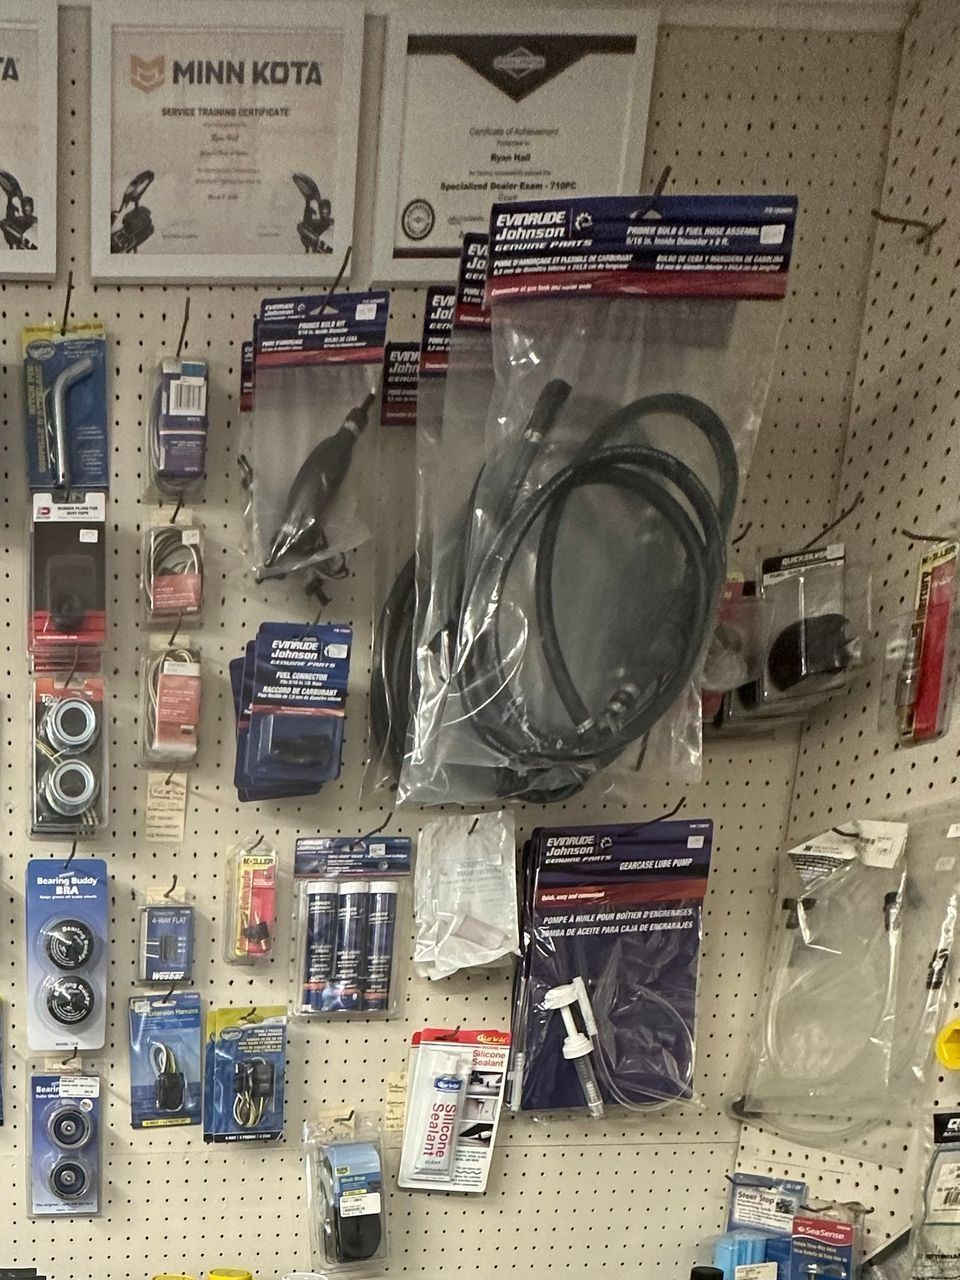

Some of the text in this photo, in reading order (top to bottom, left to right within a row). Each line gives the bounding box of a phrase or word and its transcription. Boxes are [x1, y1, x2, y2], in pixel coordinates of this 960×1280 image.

[173, 60, 322, 86] MINN KOTA
[197, 107, 290, 117] TRAINING CERTIFICATE
[490, 152, 531, 164] Ryan Hall
[496, 211, 567, 227] EVINRUDE
[495, 226, 566, 241] Johnson
[626, 225, 724, 236] PRIMER FUEL HOSE
[271, 640, 319, 651] EVINRUDE
[271, 649, 318, 661] Johnson
[546, 835, 594, 847] EVINRUDE
[545, 845, 594, 857] Johnson
[619, 857, 693, 871] GEARCASE LUBE PUMP
[37, 875, 99, 887] Bearing Buddy
[55, 886, 80, 895] BRA
[171, 915, 187, 924] FLAT
[575, 924, 620, 936] ACEITE PARA
[152, 971, 185, 981] Wesbar
[472, 1049, 506, 1060] Silicone
[471, 1058, 504, 1068] Sealant
[422, 1102, 445, 1156] Sealant
[435, 1104, 457, 1158] Silicone
[738, 1190, 775, 1205] Steer Stop
[805, 1227, 845, 1240] SeaSense
